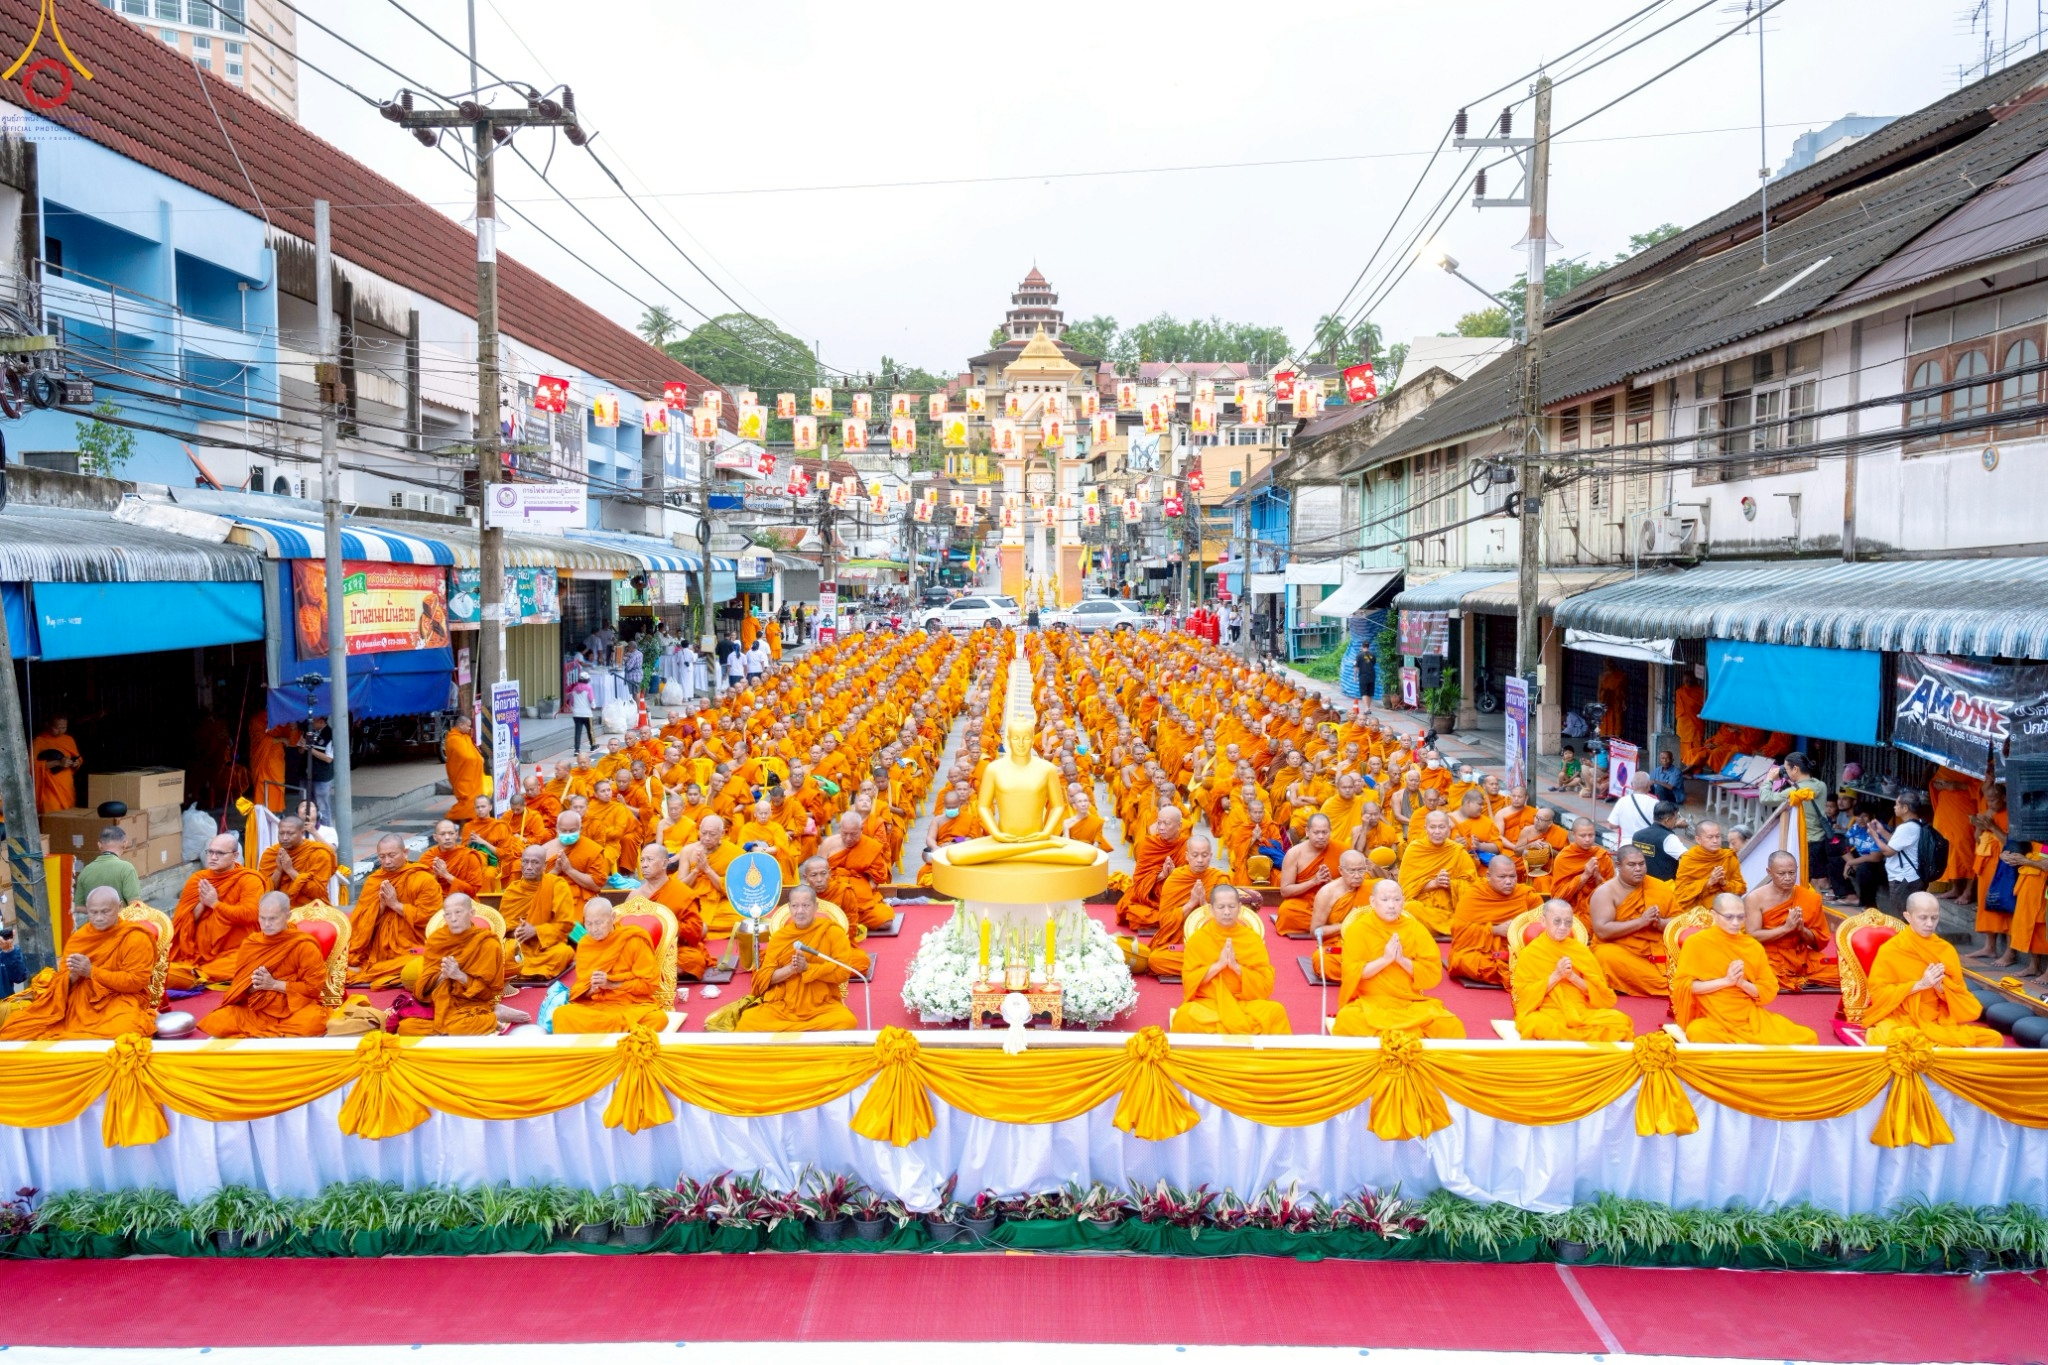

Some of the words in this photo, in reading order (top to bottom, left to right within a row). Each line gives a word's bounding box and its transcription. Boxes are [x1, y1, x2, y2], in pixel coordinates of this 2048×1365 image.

[755, 486, 783, 497] SCG
[1897, 674, 2015, 740] AMONE
[497, 731, 506, 745] 14
[1507, 724, 1515, 738] 14
[1932, 721, 1945, 733] TOP
[1945, 726, 1966, 740] CLASS
[1966, 732, 2003, 750] LUBRICTS
